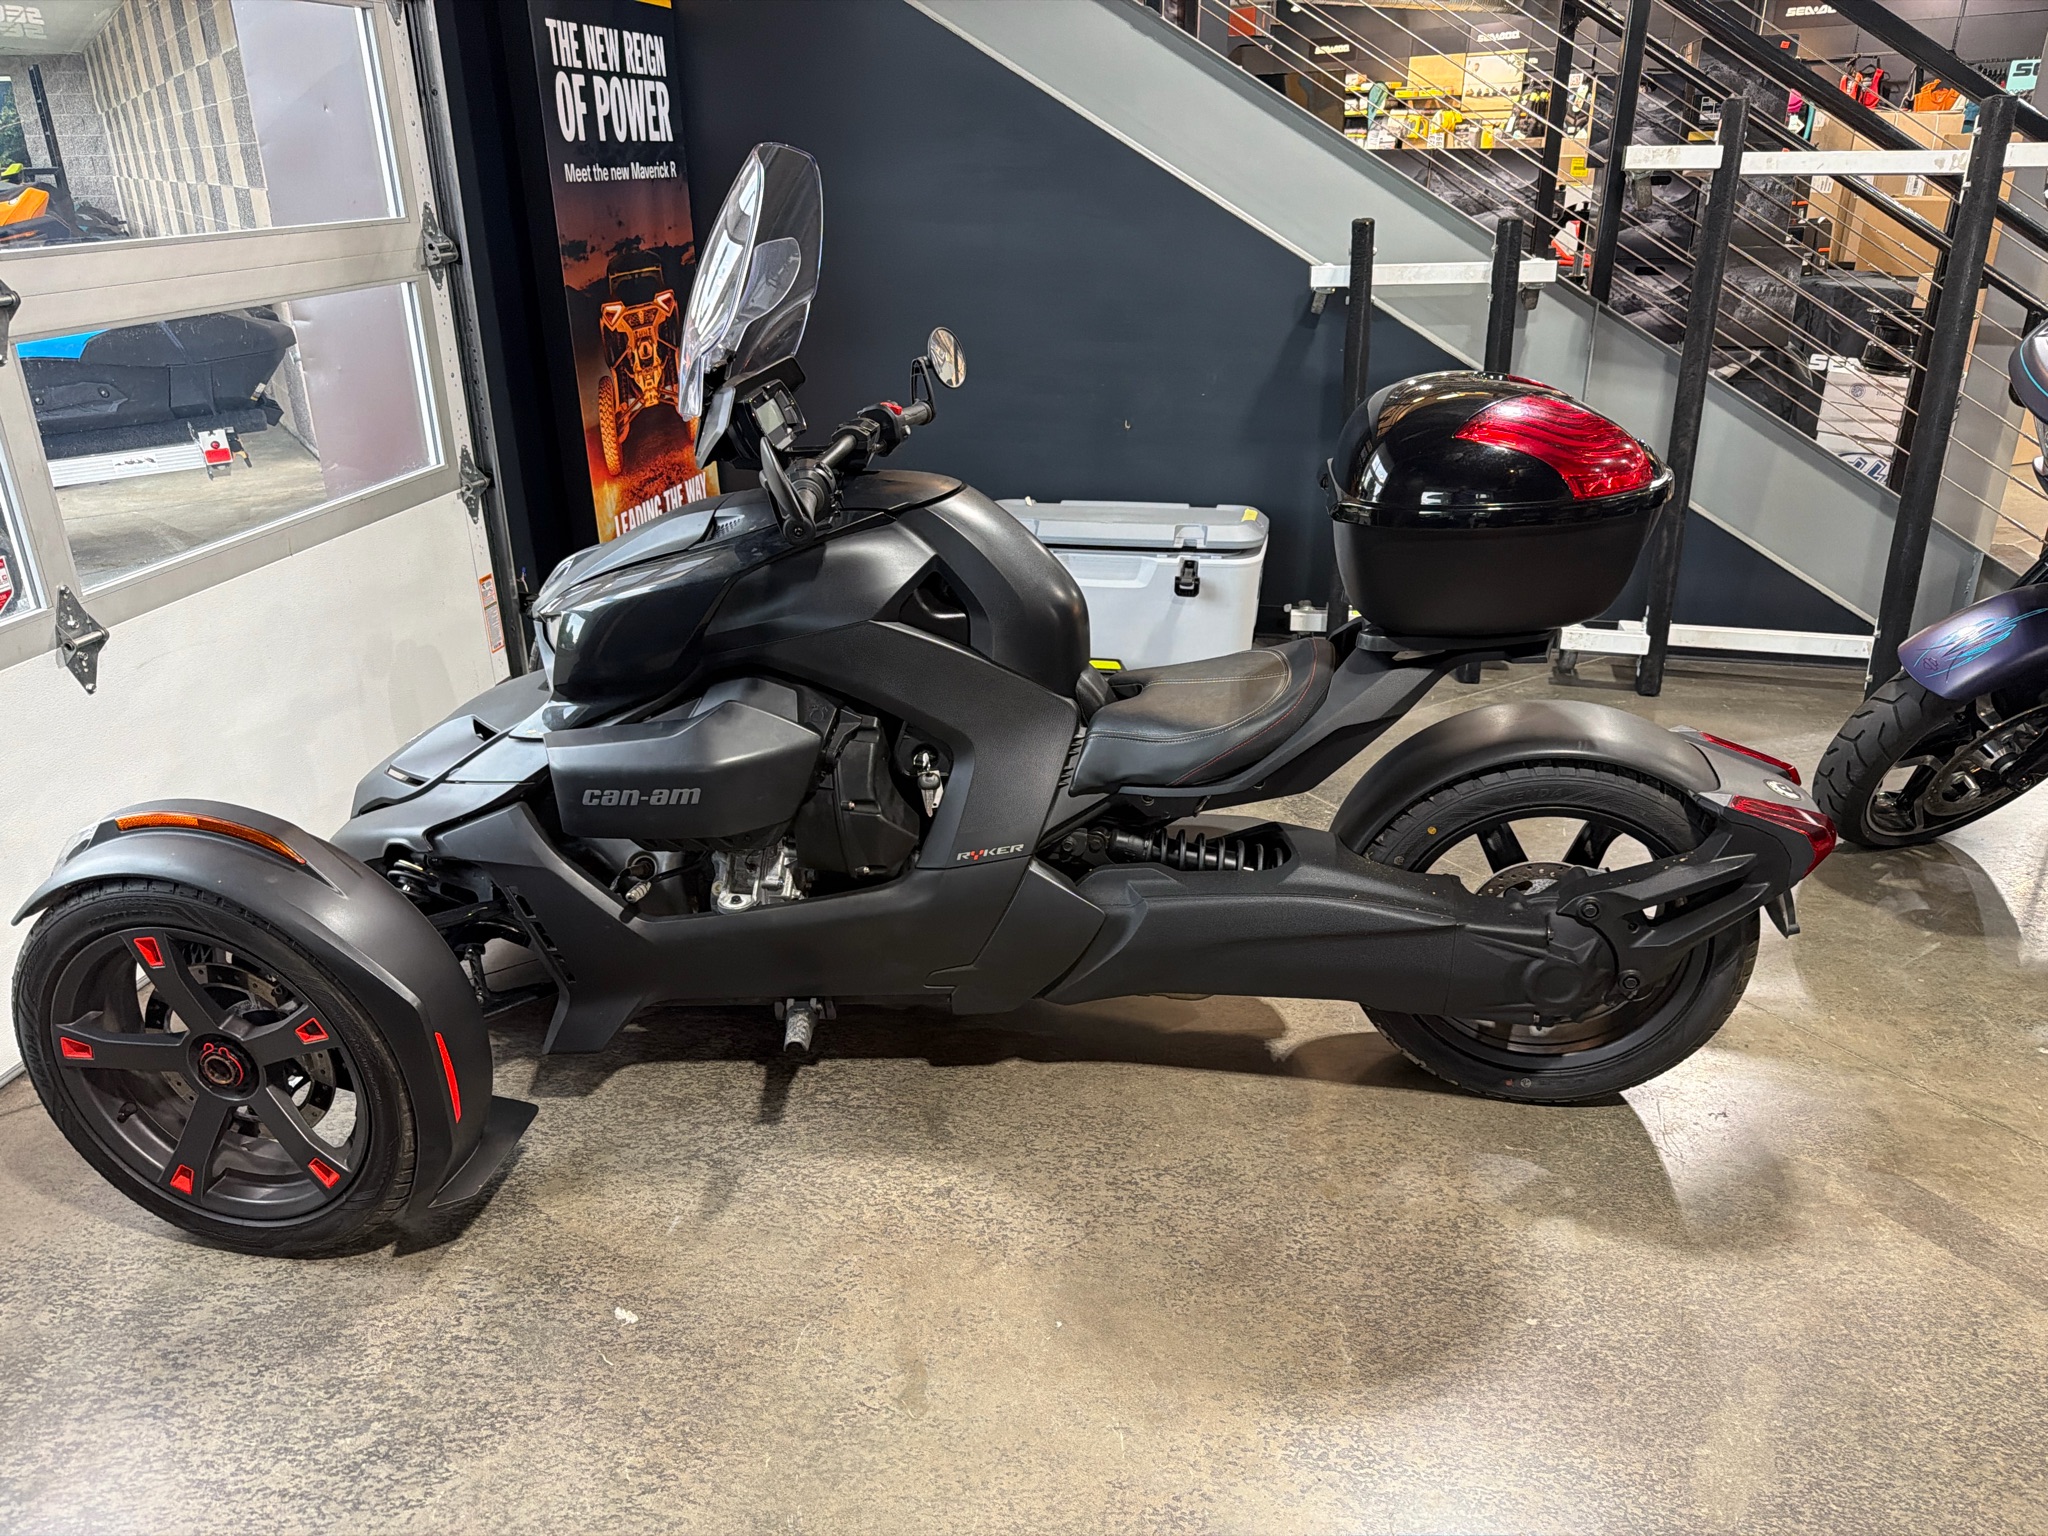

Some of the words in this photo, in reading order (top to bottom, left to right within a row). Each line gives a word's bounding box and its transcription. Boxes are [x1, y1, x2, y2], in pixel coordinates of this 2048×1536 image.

[545, 18, 582, 68] THE
[582, 24, 620, 72] NEW
[622, 29, 667, 77] REIGN
[555, 71, 587, 142] OF
[593, 76, 673, 142] POWER
[564, 162, 591, 183] Meet
[592, 163, 609, 181] the
[610, 167, 629, 181] new
[630, 161, 669, 180] Maverick
[670, 161, 677, 178] R
[614, 495, 662, 537] LEADING
[664, 484, 683, 512] THE
[685, 472, 706, 503] WAY
[582, 788, 701, 806] can-am
[956, 844, 1024, 860] RYKER
